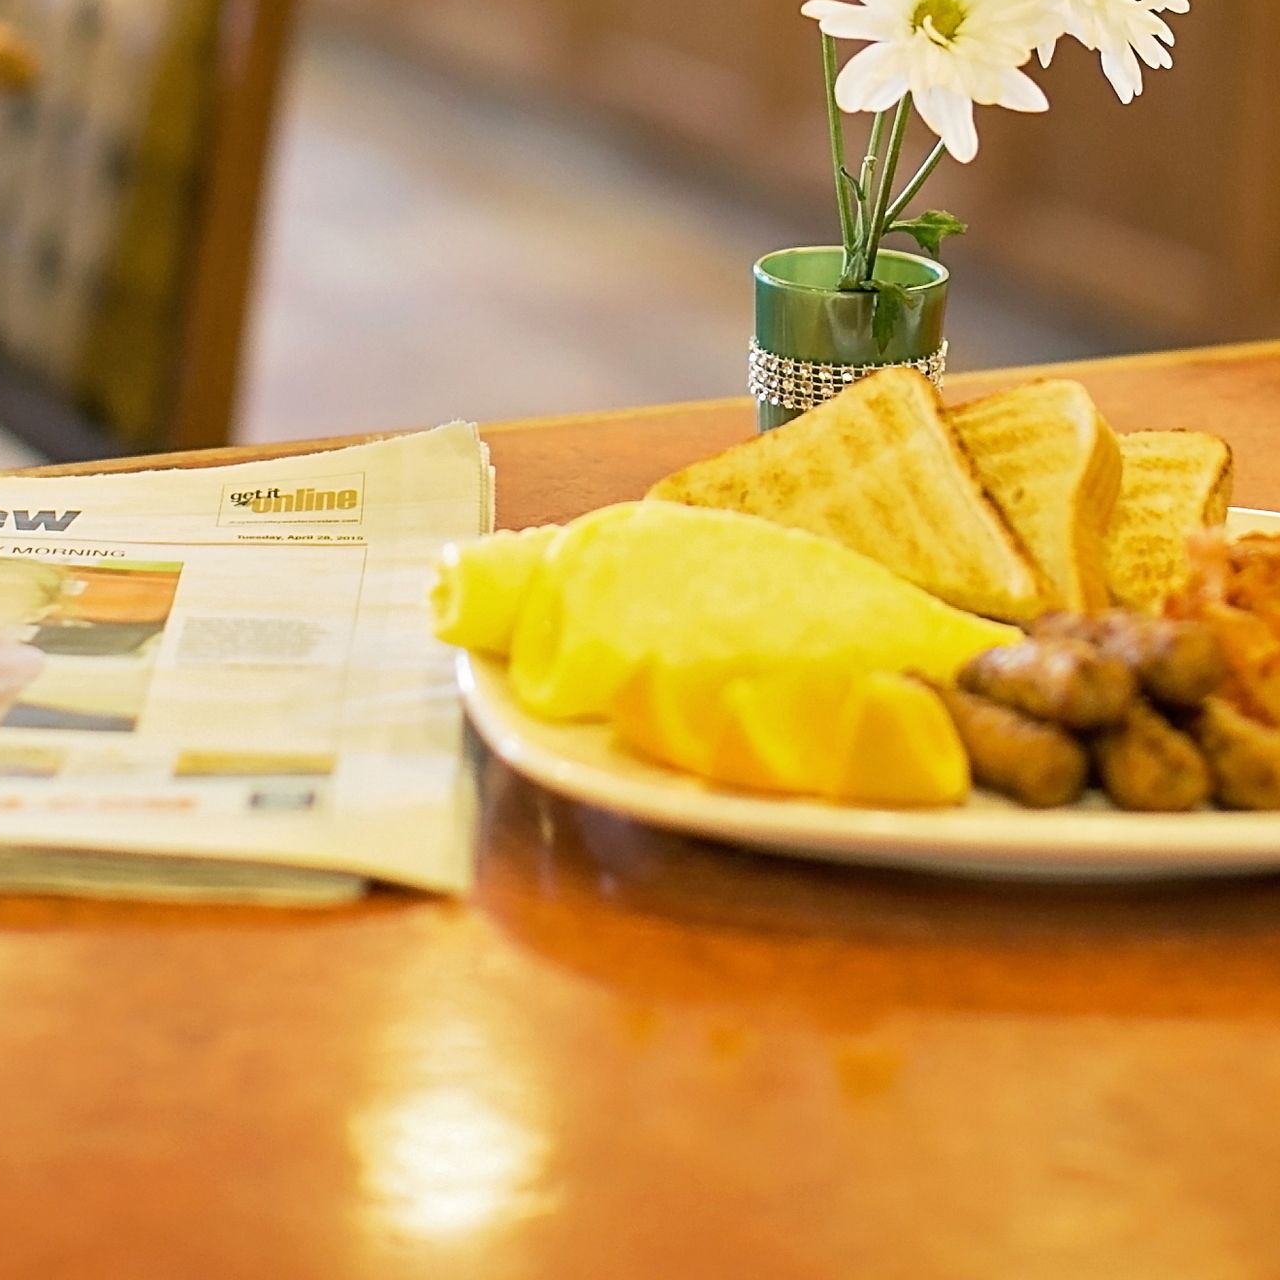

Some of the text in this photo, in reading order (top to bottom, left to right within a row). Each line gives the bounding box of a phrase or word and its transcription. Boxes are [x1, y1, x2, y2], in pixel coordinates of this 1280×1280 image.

[230, 488, 281, 503] get it
[251, 488, 358, 514] online
[11, 545, 126, 558] MORNING
